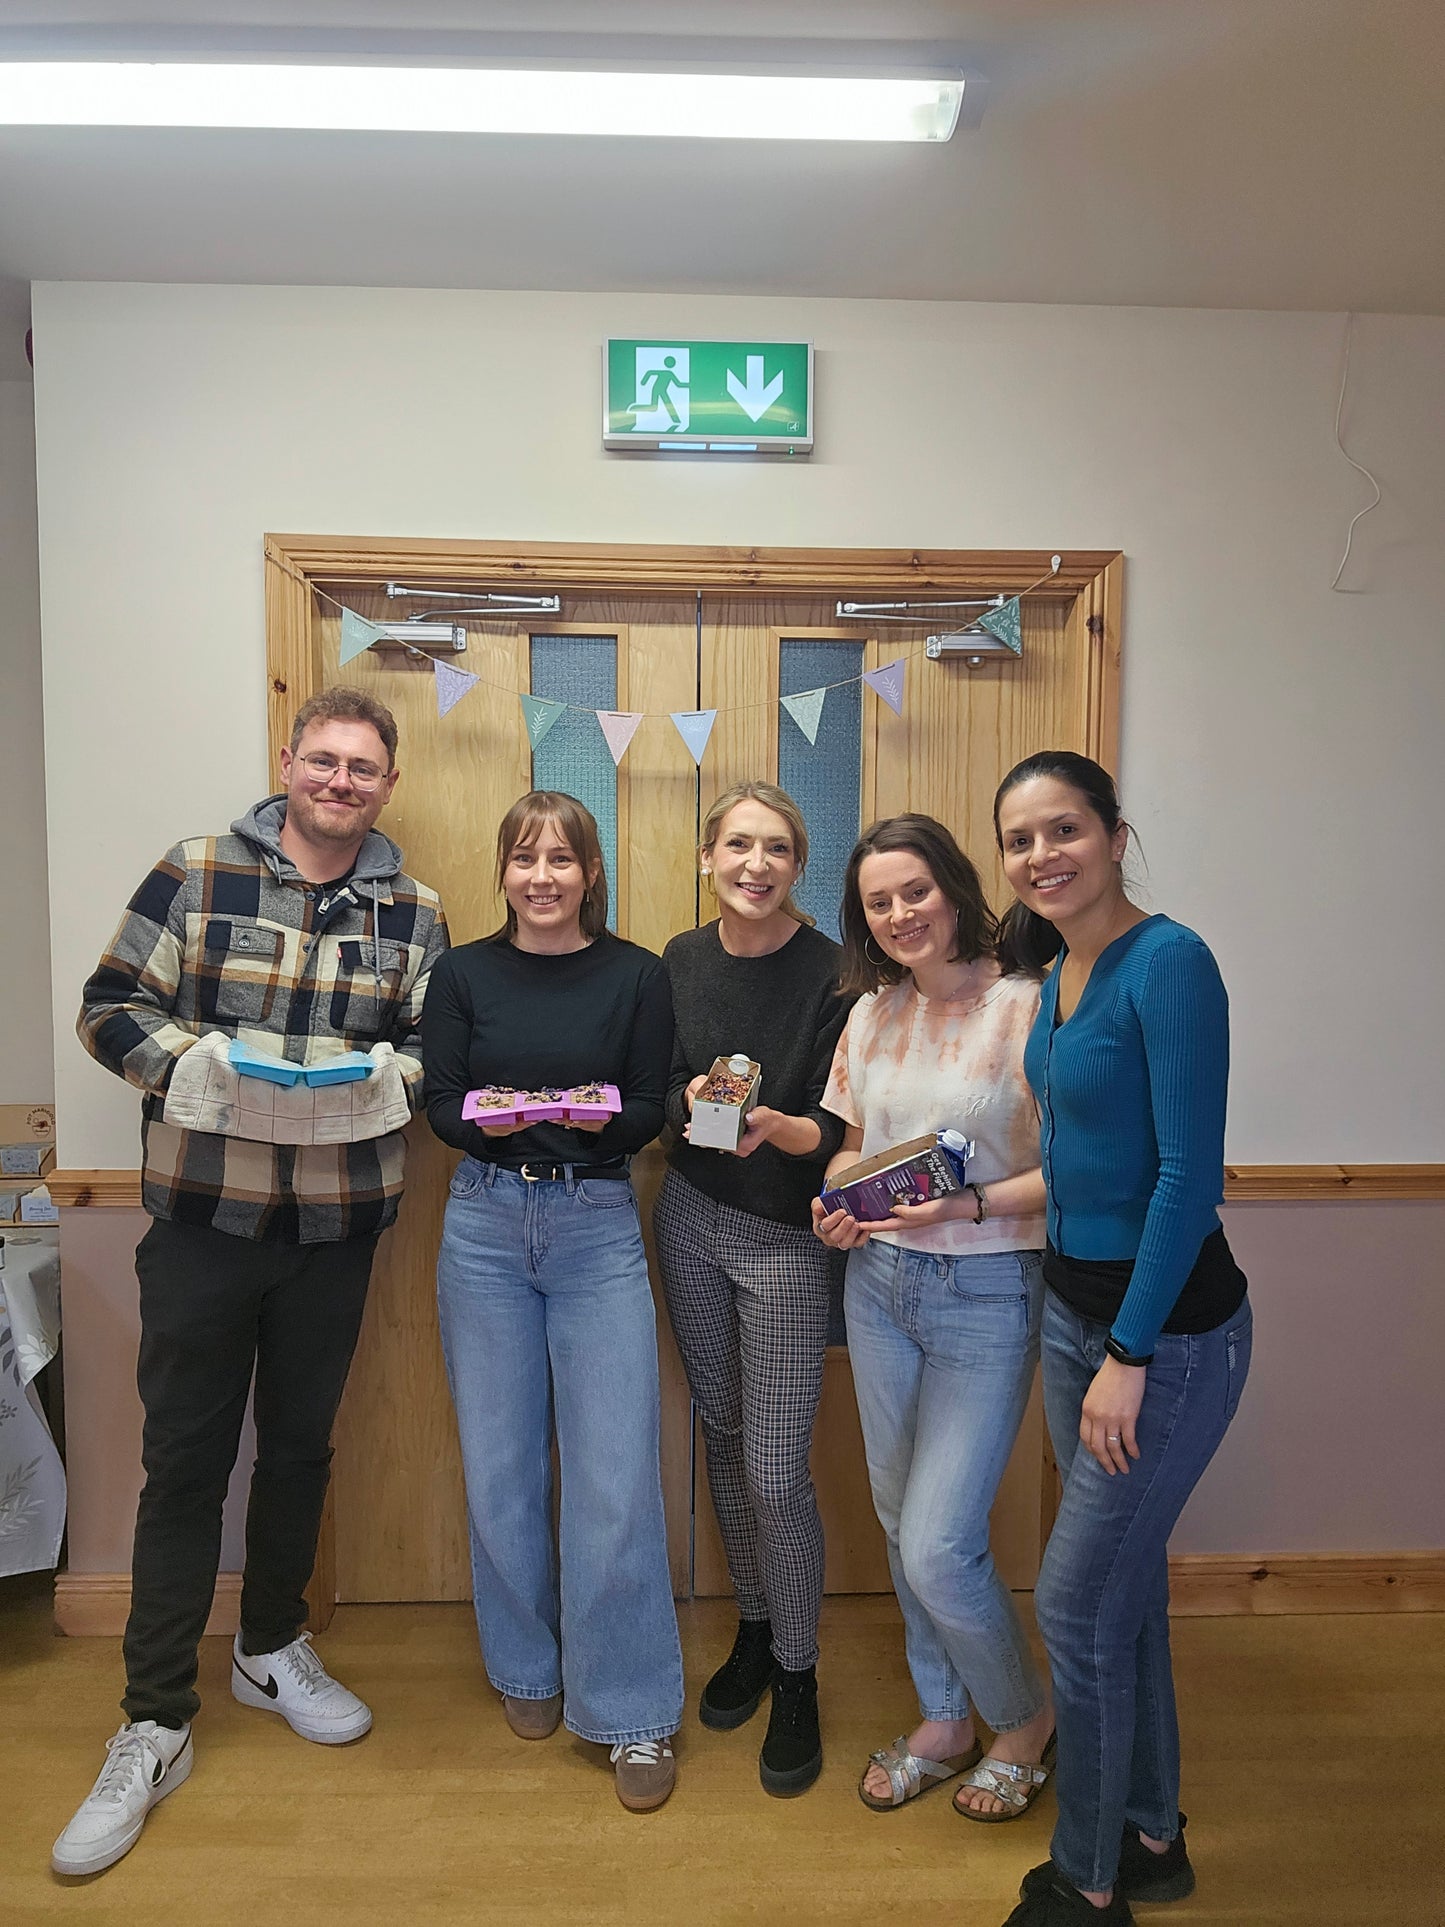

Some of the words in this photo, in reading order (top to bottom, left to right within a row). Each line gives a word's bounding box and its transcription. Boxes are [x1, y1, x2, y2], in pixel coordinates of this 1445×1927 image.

[32, 1108, 56, 1125] MARIGOLD
[926, 1158, 936, 1172] The
[932, 1172, 946, 1190] Fight
[931, 1152, 942, 1166] Get
[938, 1166, 956, 1191] Behind
